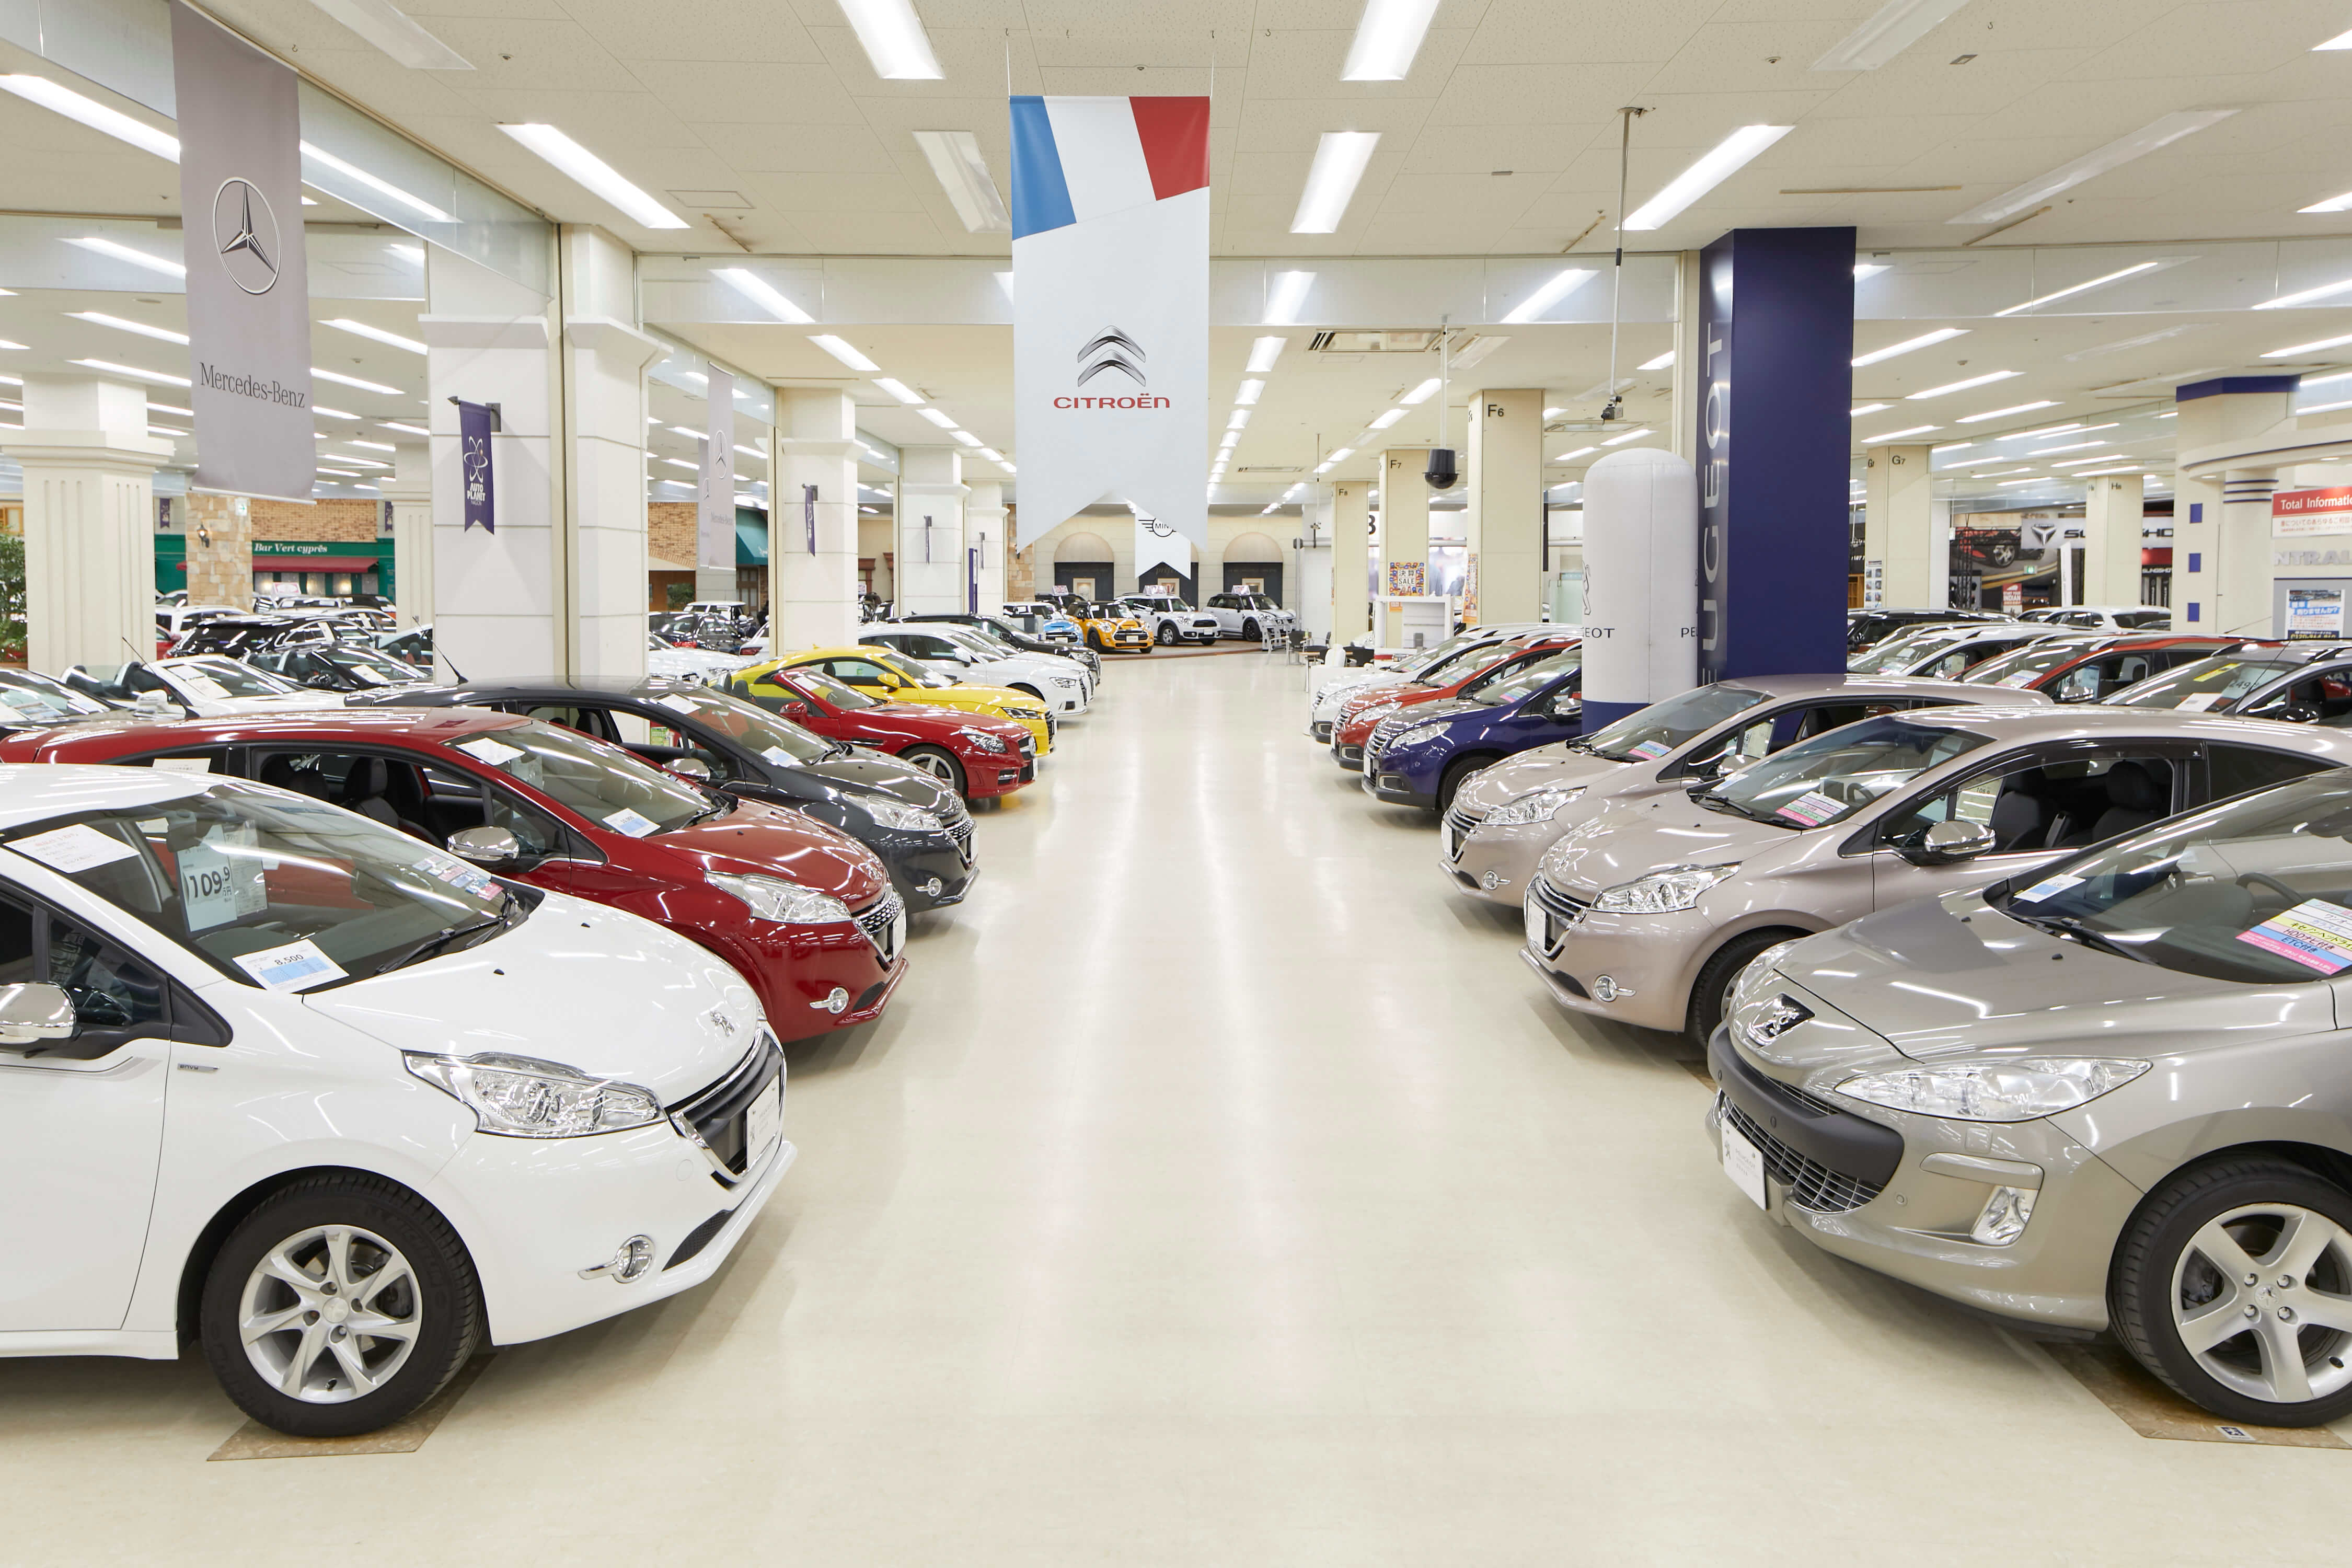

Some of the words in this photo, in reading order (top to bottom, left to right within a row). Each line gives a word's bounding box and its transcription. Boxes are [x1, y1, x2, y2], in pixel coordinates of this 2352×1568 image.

[200, 362, 305, 408] Mercedes-Benz
[1488, 404, 1504, 417] F6
[1390, 460, 1402, 469] F7
[1892, 455, 1906, 465] G7
[470, 482, 483, 492] AUTO
[467, 489, 486, 502] PLANET
[2280, 498, 2303, 510] Total
[255, 543, 272, 552] Bar
[275, 544, 295, 552] Vert
[1681, 627, 1698, 638] PE
[2281, 937, 2318, 953] ETC付き
[2282, 928, 2335, 950] HDDナビ付き
[274, 954, 304, 966] 8,500
